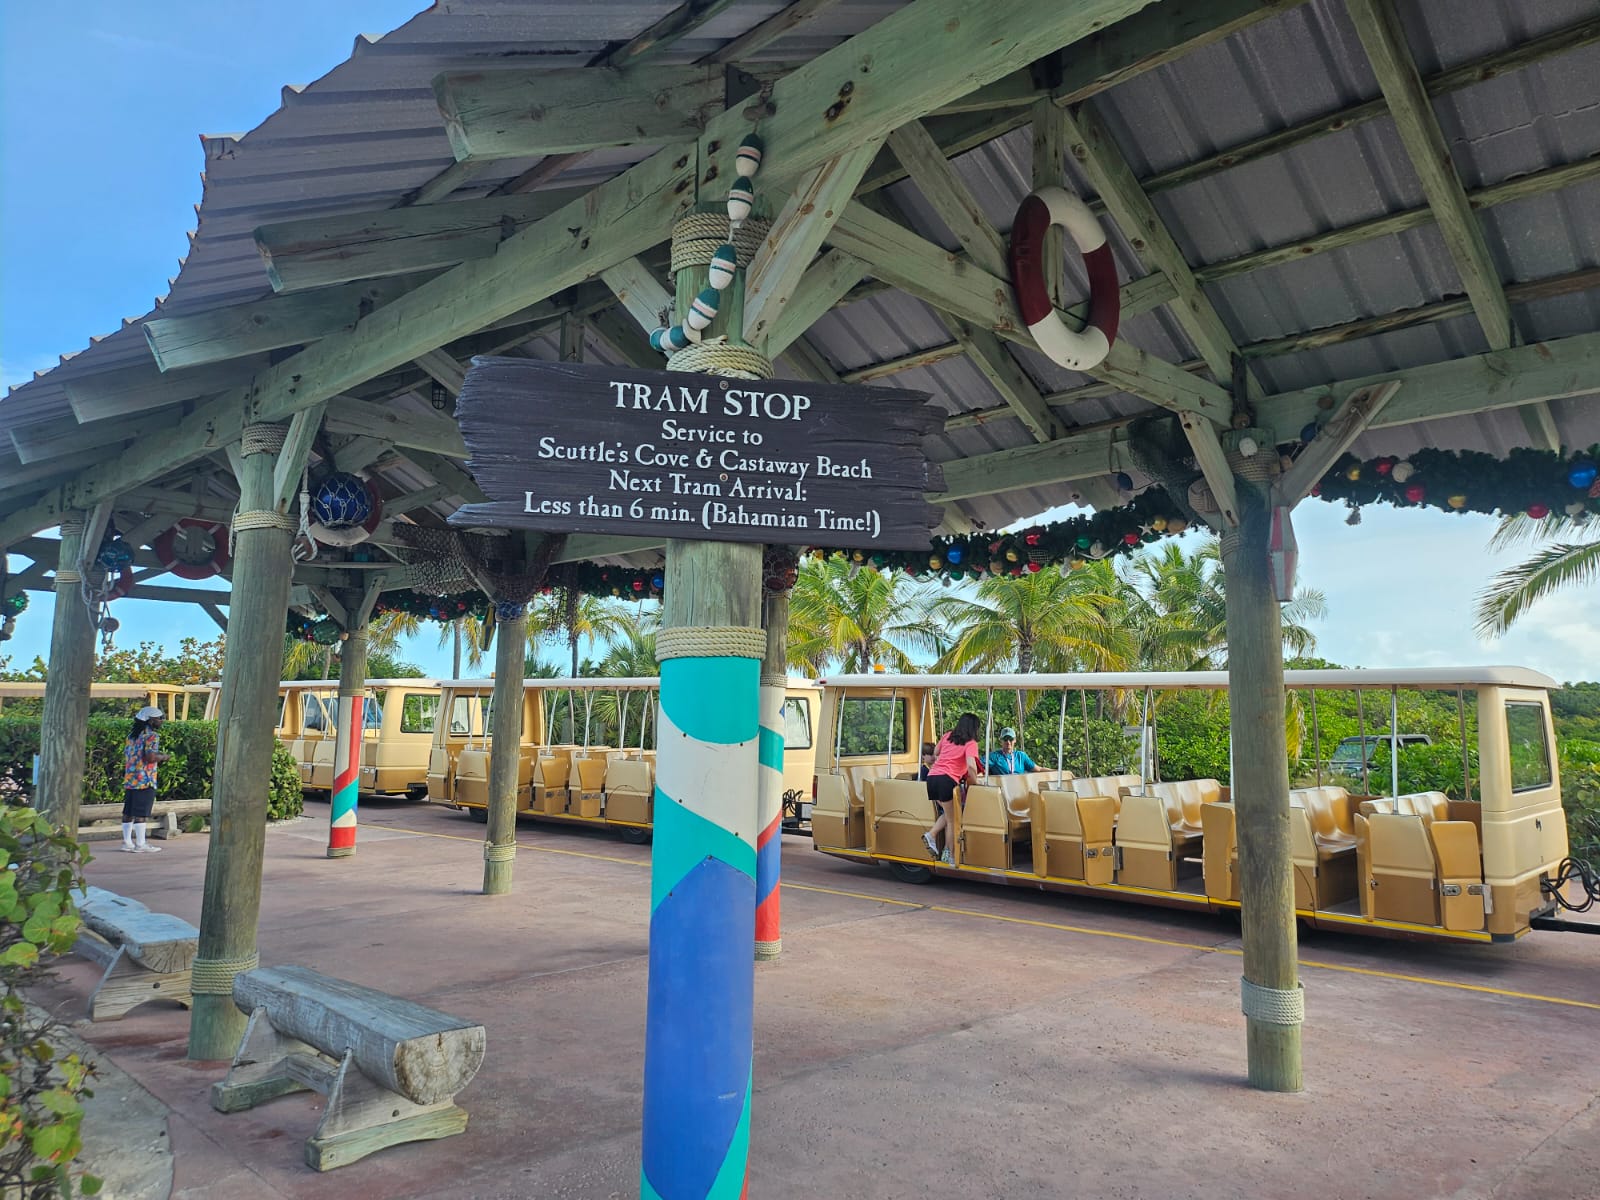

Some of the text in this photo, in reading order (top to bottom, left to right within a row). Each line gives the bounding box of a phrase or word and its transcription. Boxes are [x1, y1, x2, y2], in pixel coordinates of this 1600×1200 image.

[610, 381, 811, 422] TRAM STOP
[661, 419, 763, 446] Service to
[538, 437, 872, 481] Scuttle's Cove & Castaway Beach
[609, 470, 808, 503] Next Tram Arrival:
[524, 492, 881, 538] Less than 6 min. (Bahamian Time!)
